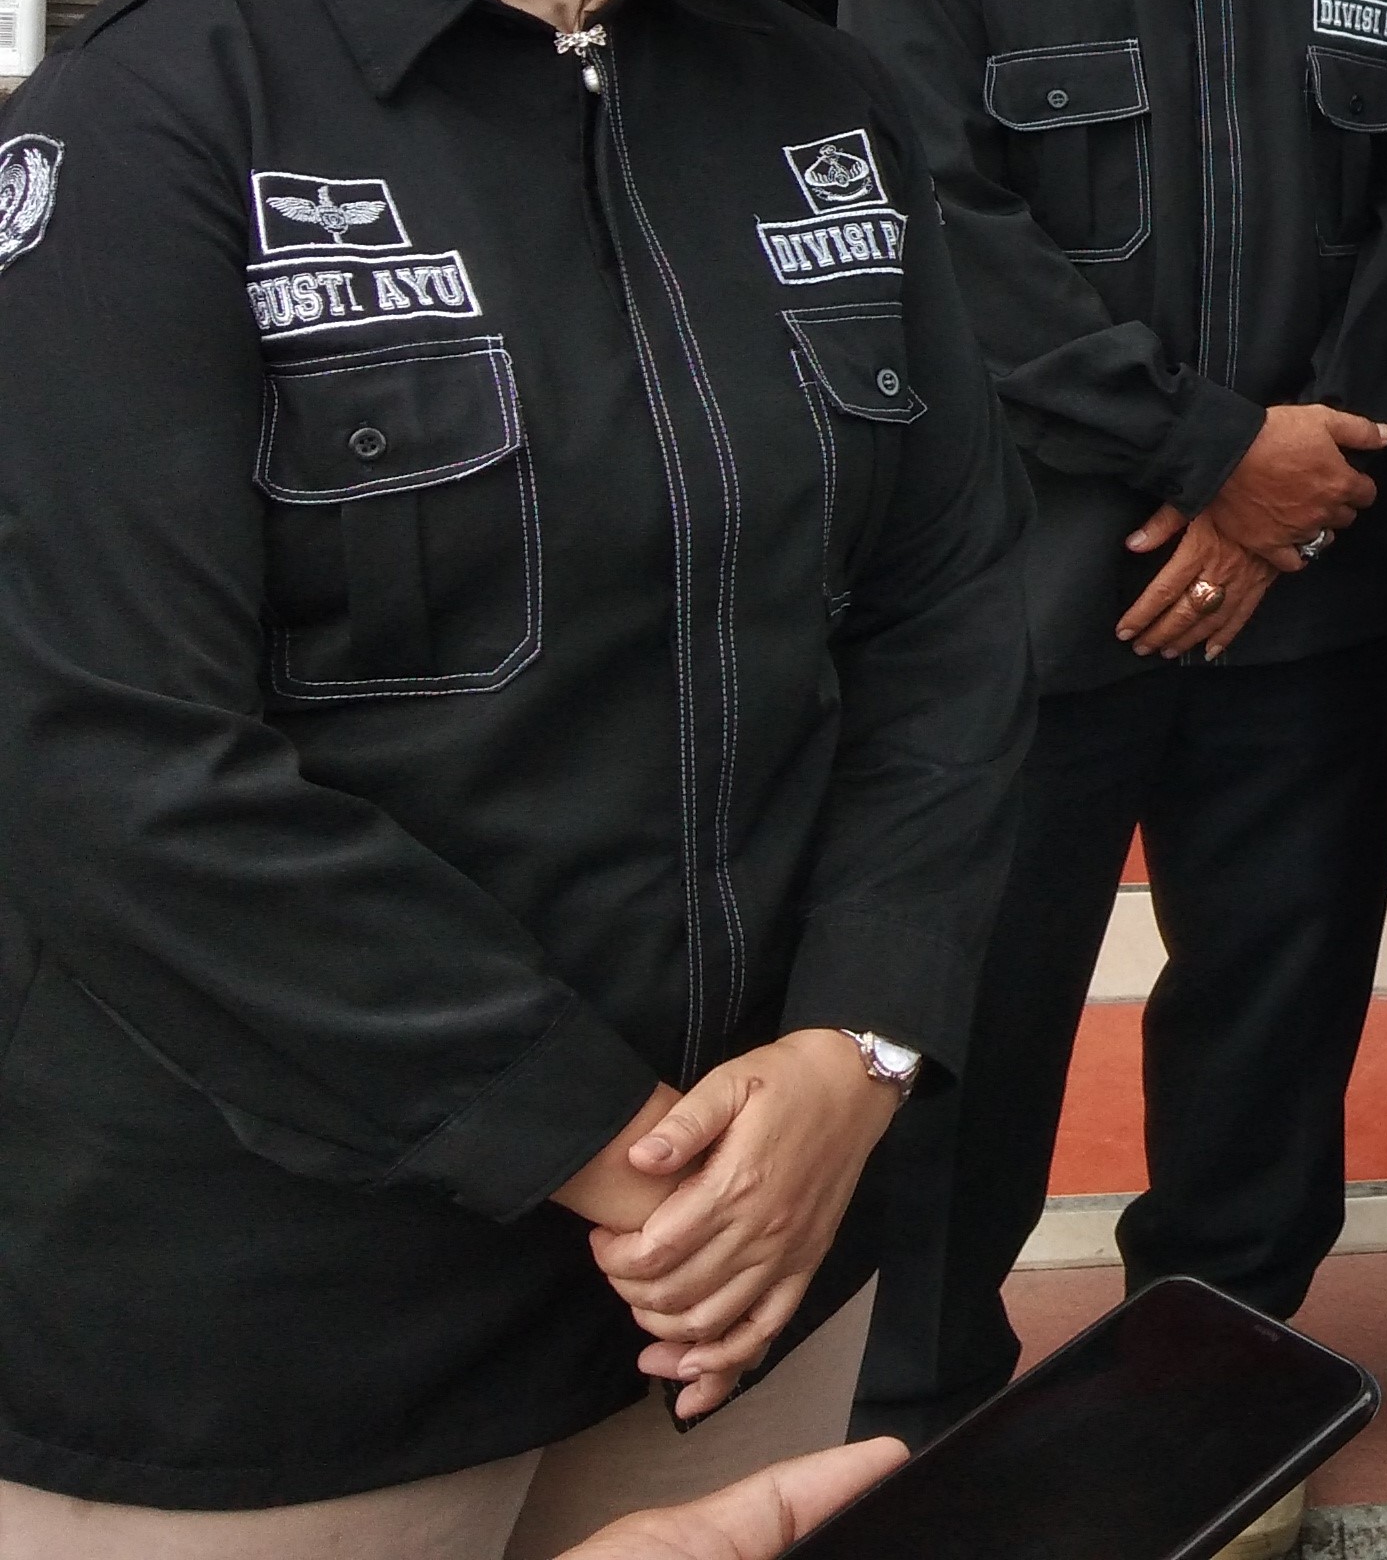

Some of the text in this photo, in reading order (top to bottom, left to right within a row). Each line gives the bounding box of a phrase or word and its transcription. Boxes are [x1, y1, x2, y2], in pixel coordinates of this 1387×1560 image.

[770, 221, 881, 272] DIVISI
[247, 265, 464, 329] GUSTI AYU
